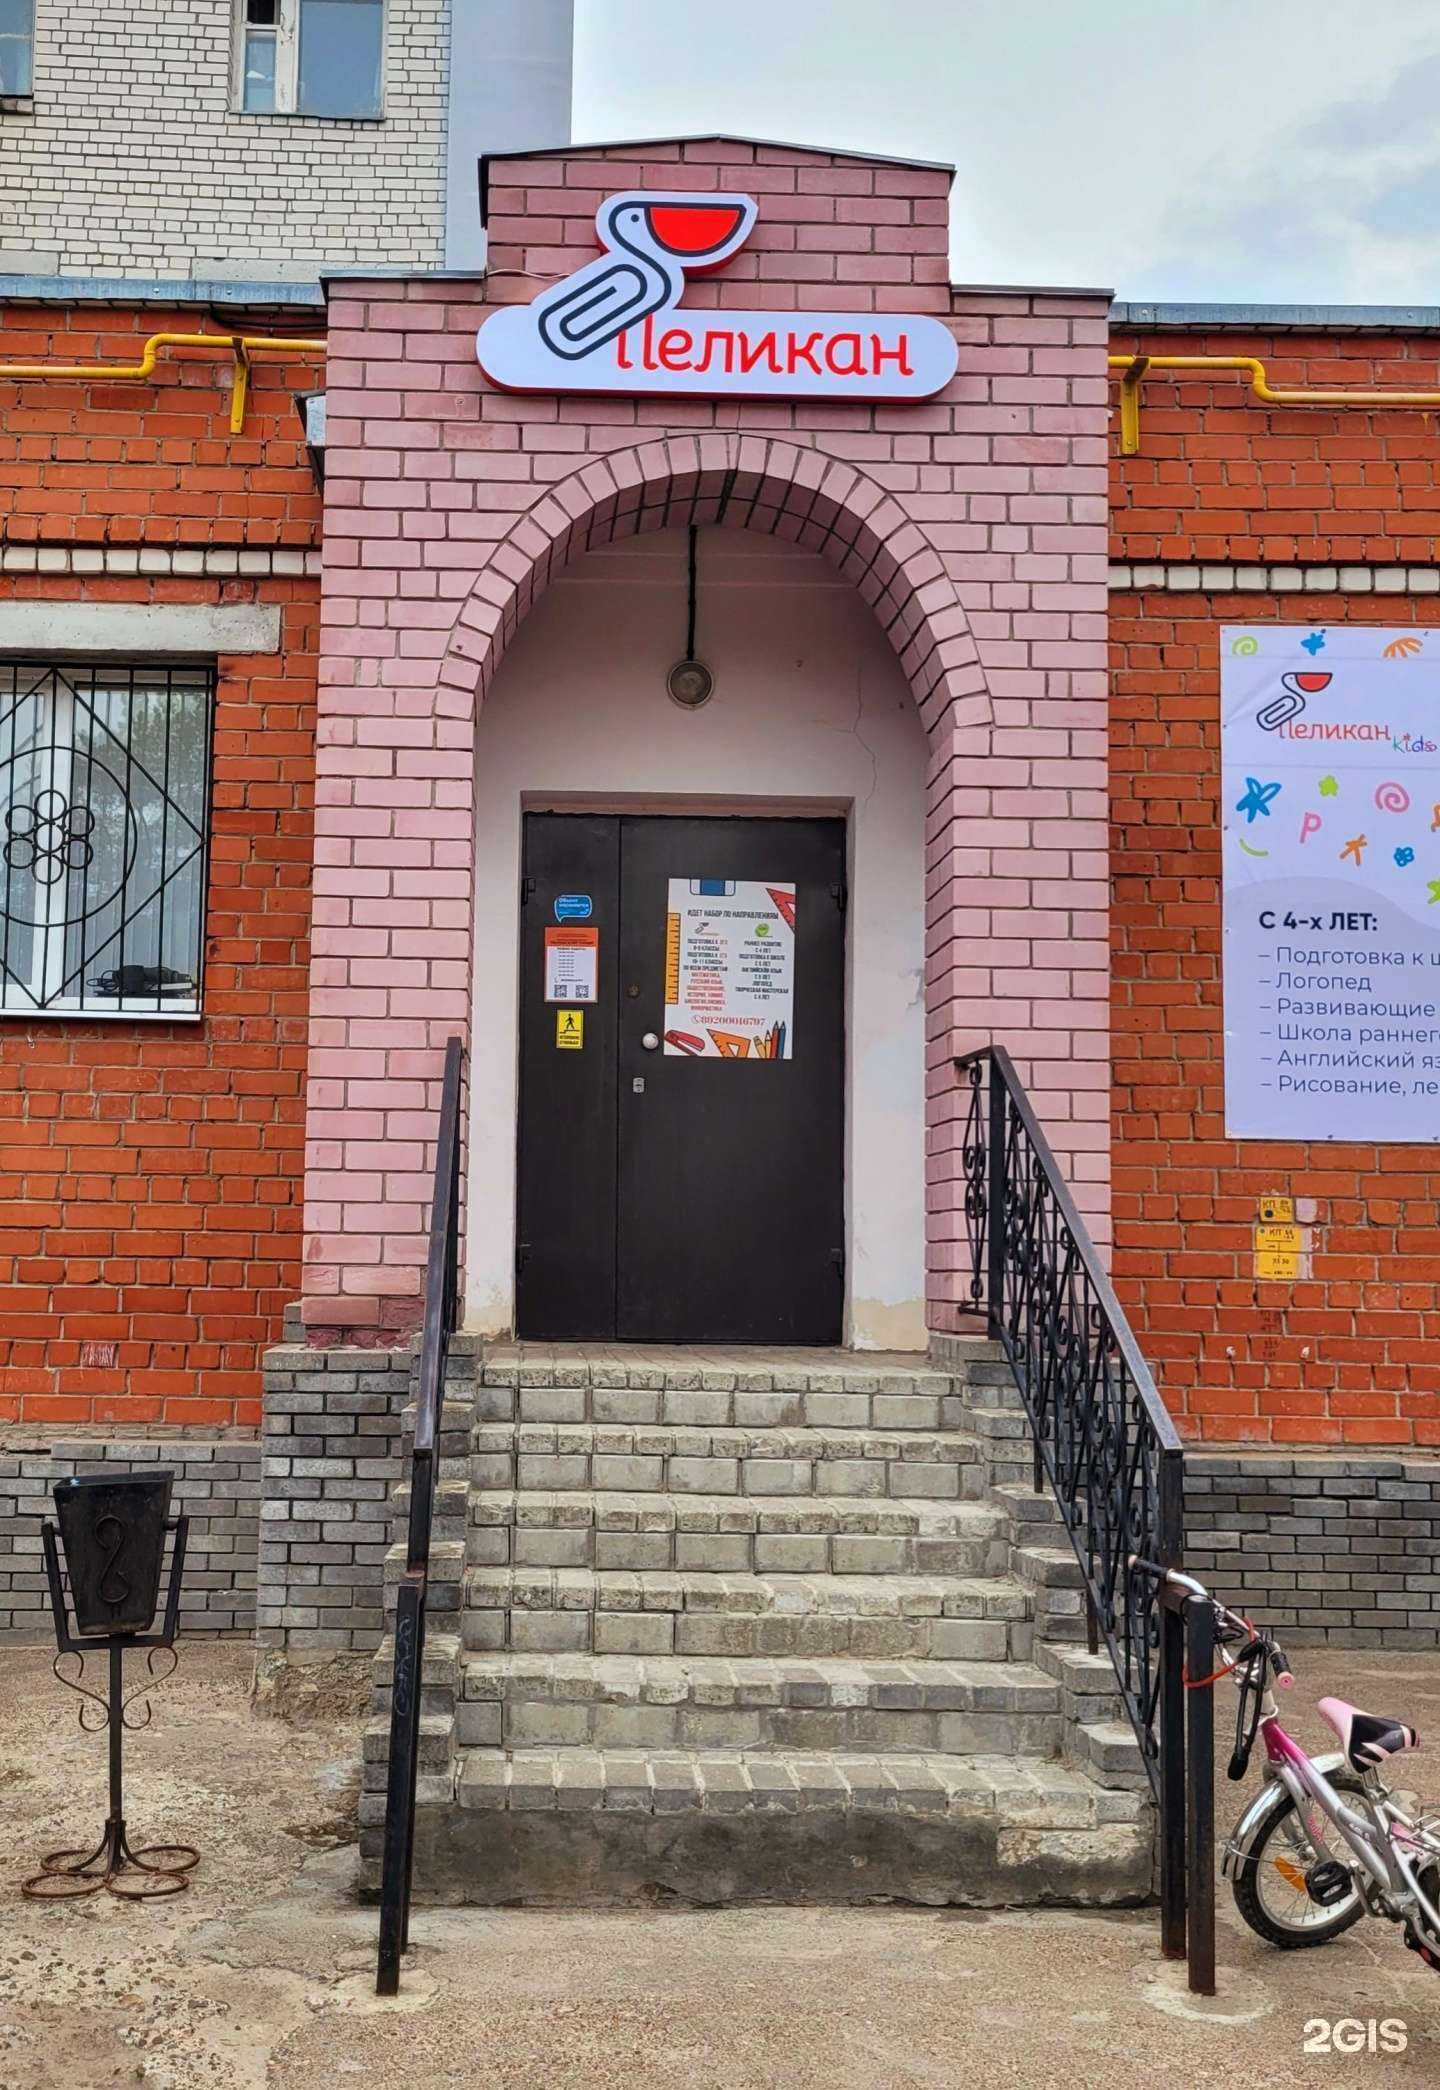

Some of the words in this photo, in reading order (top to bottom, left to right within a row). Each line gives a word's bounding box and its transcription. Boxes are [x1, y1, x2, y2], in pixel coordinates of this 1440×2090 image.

[617, 313, 914, 376] Пеликан
[1278, 718, 1391, 741] Пеликан
[1258, 910, 1277, 930] С
[1282, 911, 1323, 931] 4-х
[1328, 912, 1379, 932] ЛЕТ:
[1277, 946, 1405, 966] Подготовка
[1276, 972, 1372, 992] Логопед
[1278, 997, 1436, 1019] Развивающие
[1278, 1023, 1352, 1041] Школа
[1359, 1028, 1440, 1045] раннег
[1277, 1049, 1415, 1068] Английский
[1279, 1075, 1407, 1097] Рисование,
[1412, 1080, 1440, 1095] ле
